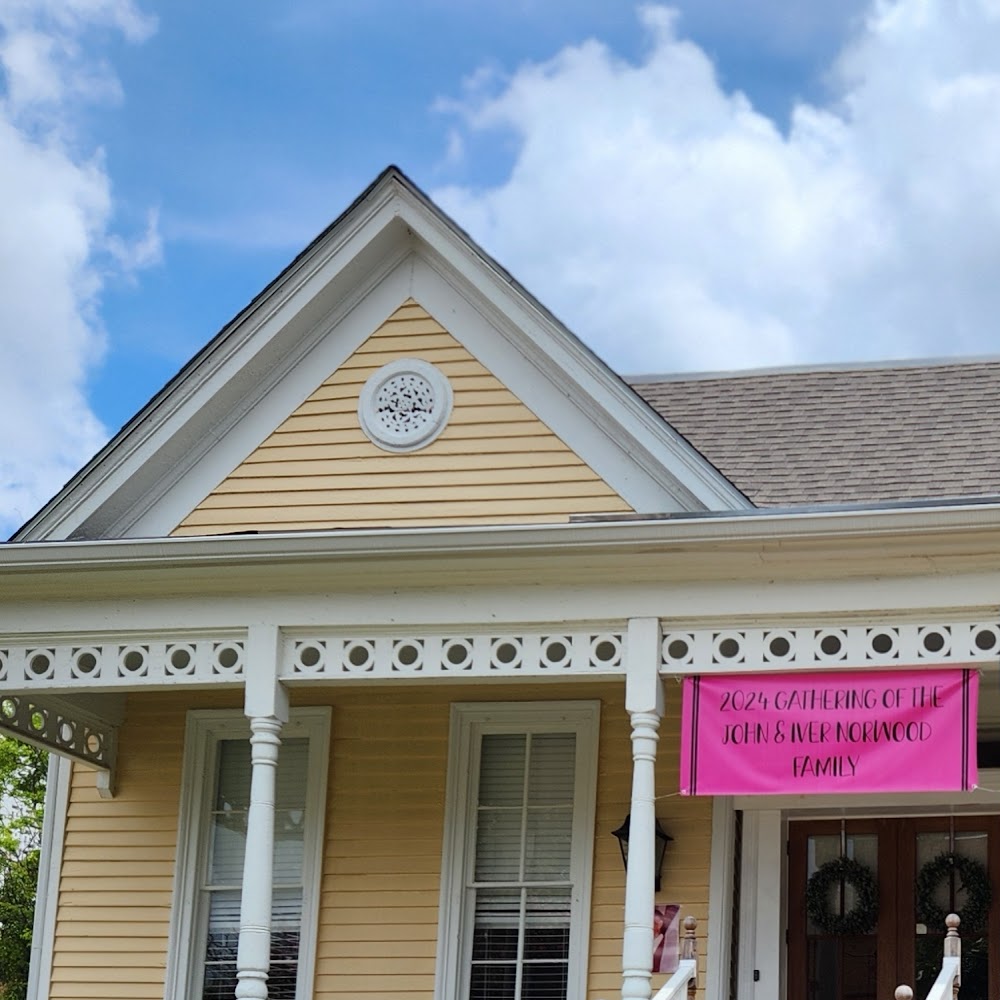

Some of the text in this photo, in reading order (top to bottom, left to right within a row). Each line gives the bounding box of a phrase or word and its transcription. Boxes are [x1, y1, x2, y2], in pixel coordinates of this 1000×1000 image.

[720, 685, 944, 711] 2024 GATHERING OF THE
[721, 720, 932, 745] JOHN & IVER NORWOOD
[793, 755, 860, 778] FAMILY
